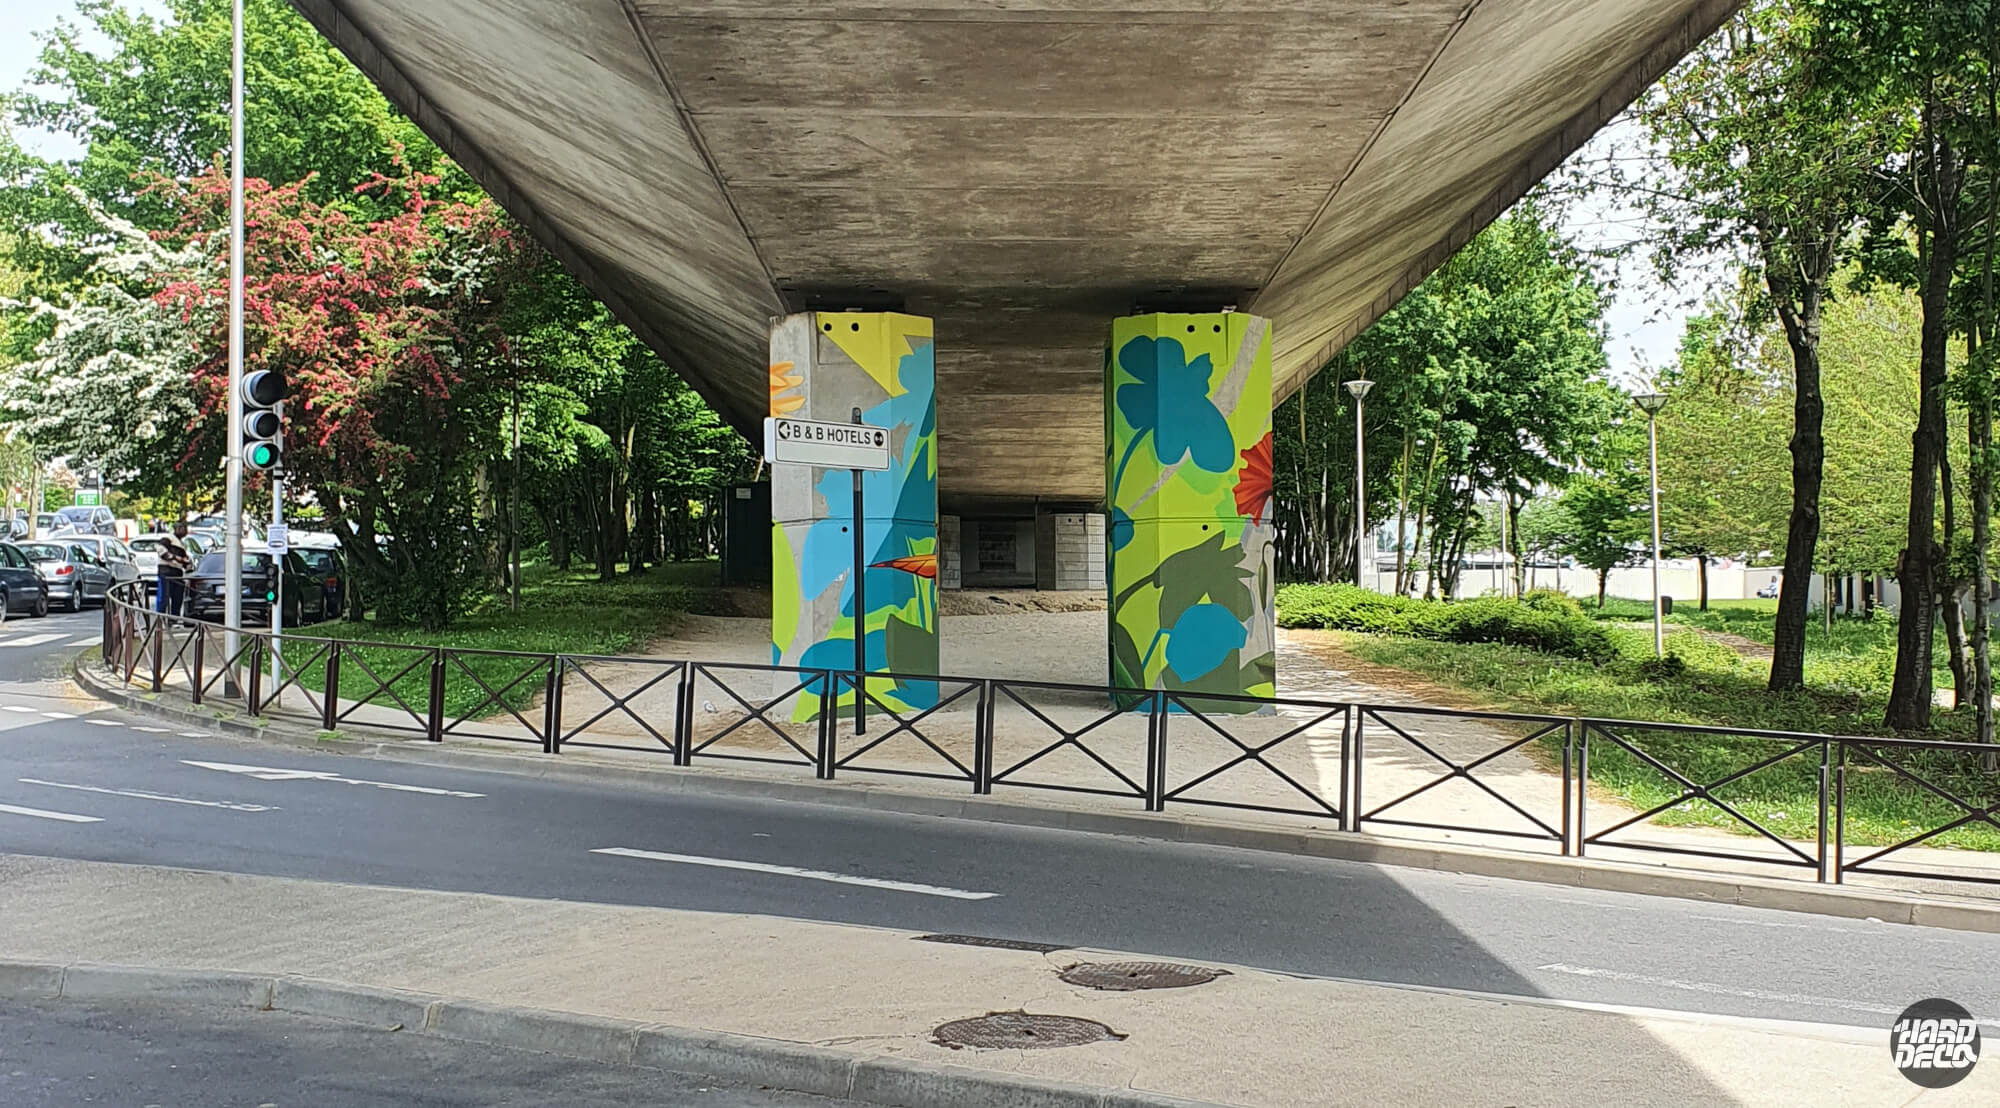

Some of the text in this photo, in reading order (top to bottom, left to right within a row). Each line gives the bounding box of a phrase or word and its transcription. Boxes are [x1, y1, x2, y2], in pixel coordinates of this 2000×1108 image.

[793, 425, 871, 445] B & B HOTELS
